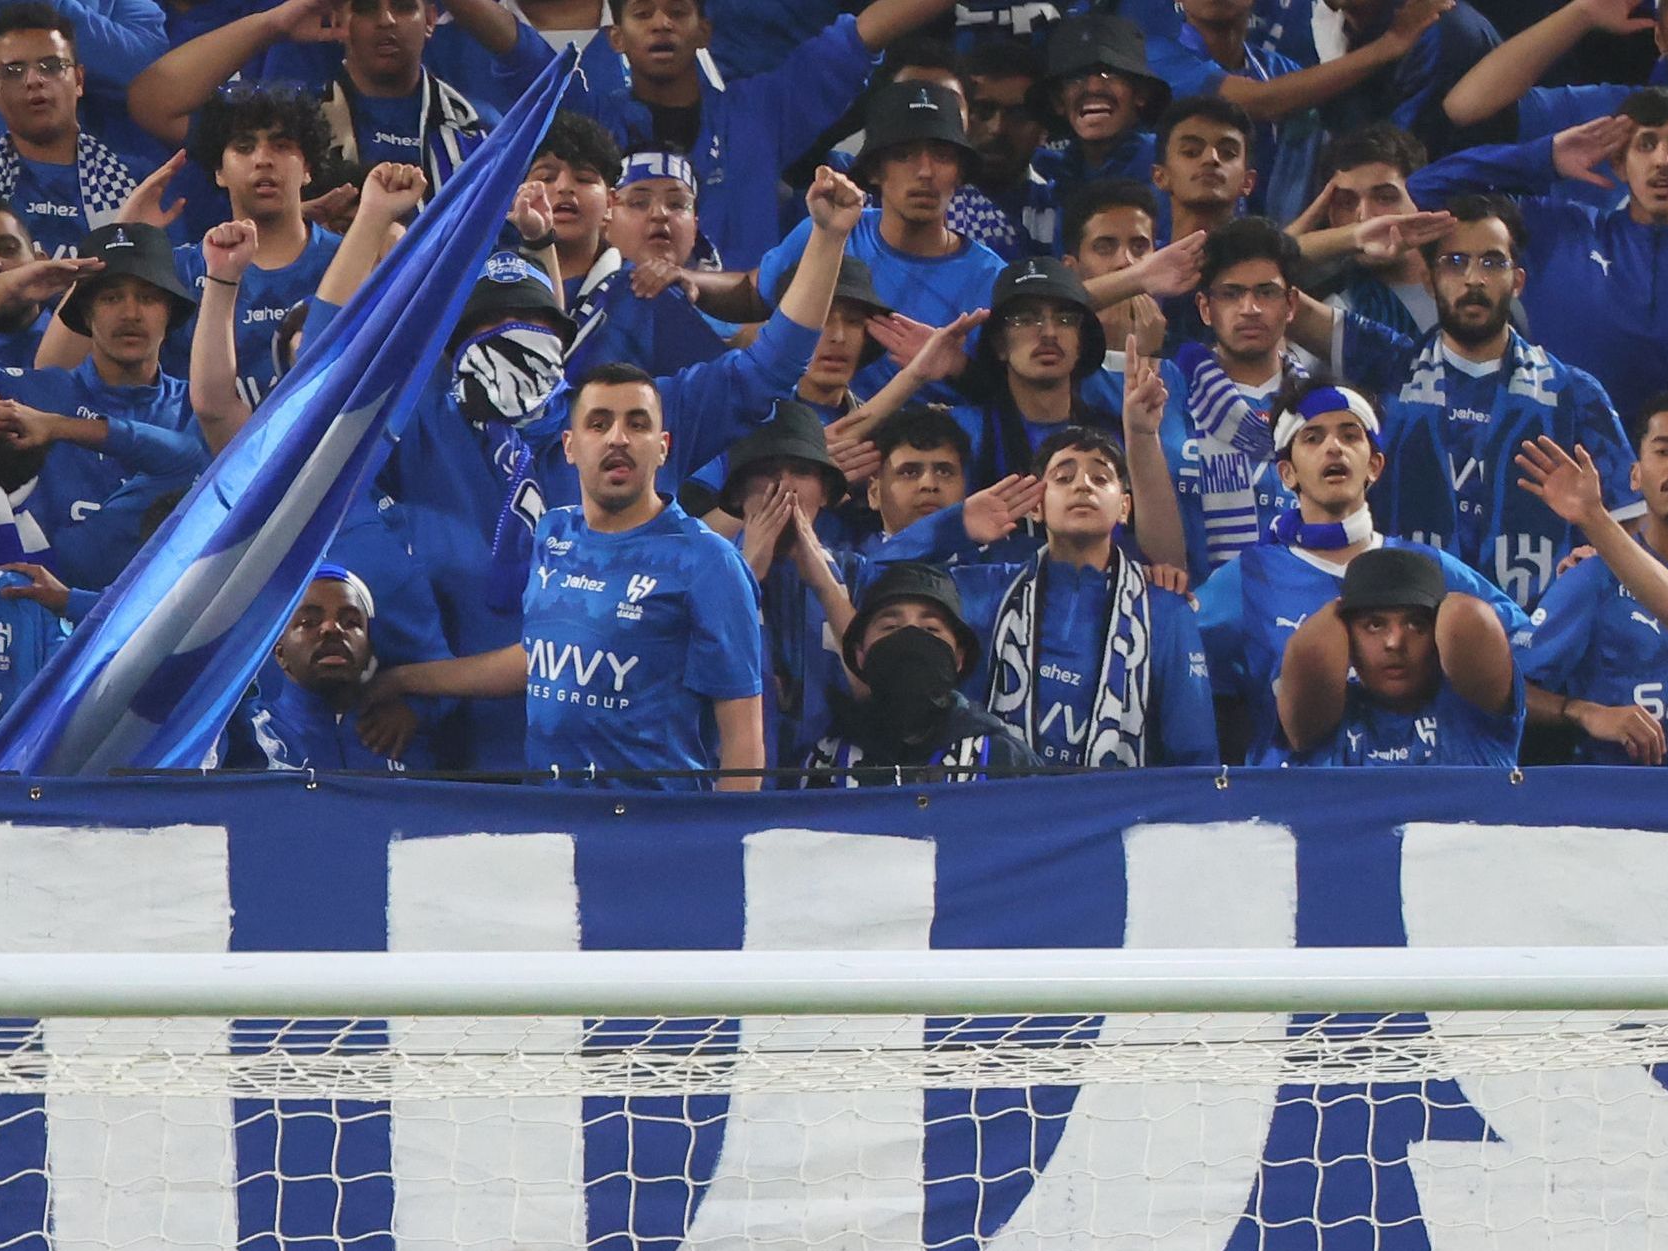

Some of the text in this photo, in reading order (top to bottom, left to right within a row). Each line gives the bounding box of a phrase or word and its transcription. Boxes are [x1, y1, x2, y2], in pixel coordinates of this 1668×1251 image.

[526, 637, 639, 692] AVVY
[1039, 663, 1082, 687] ahez
[556, 689, 630, 710] GROUP
